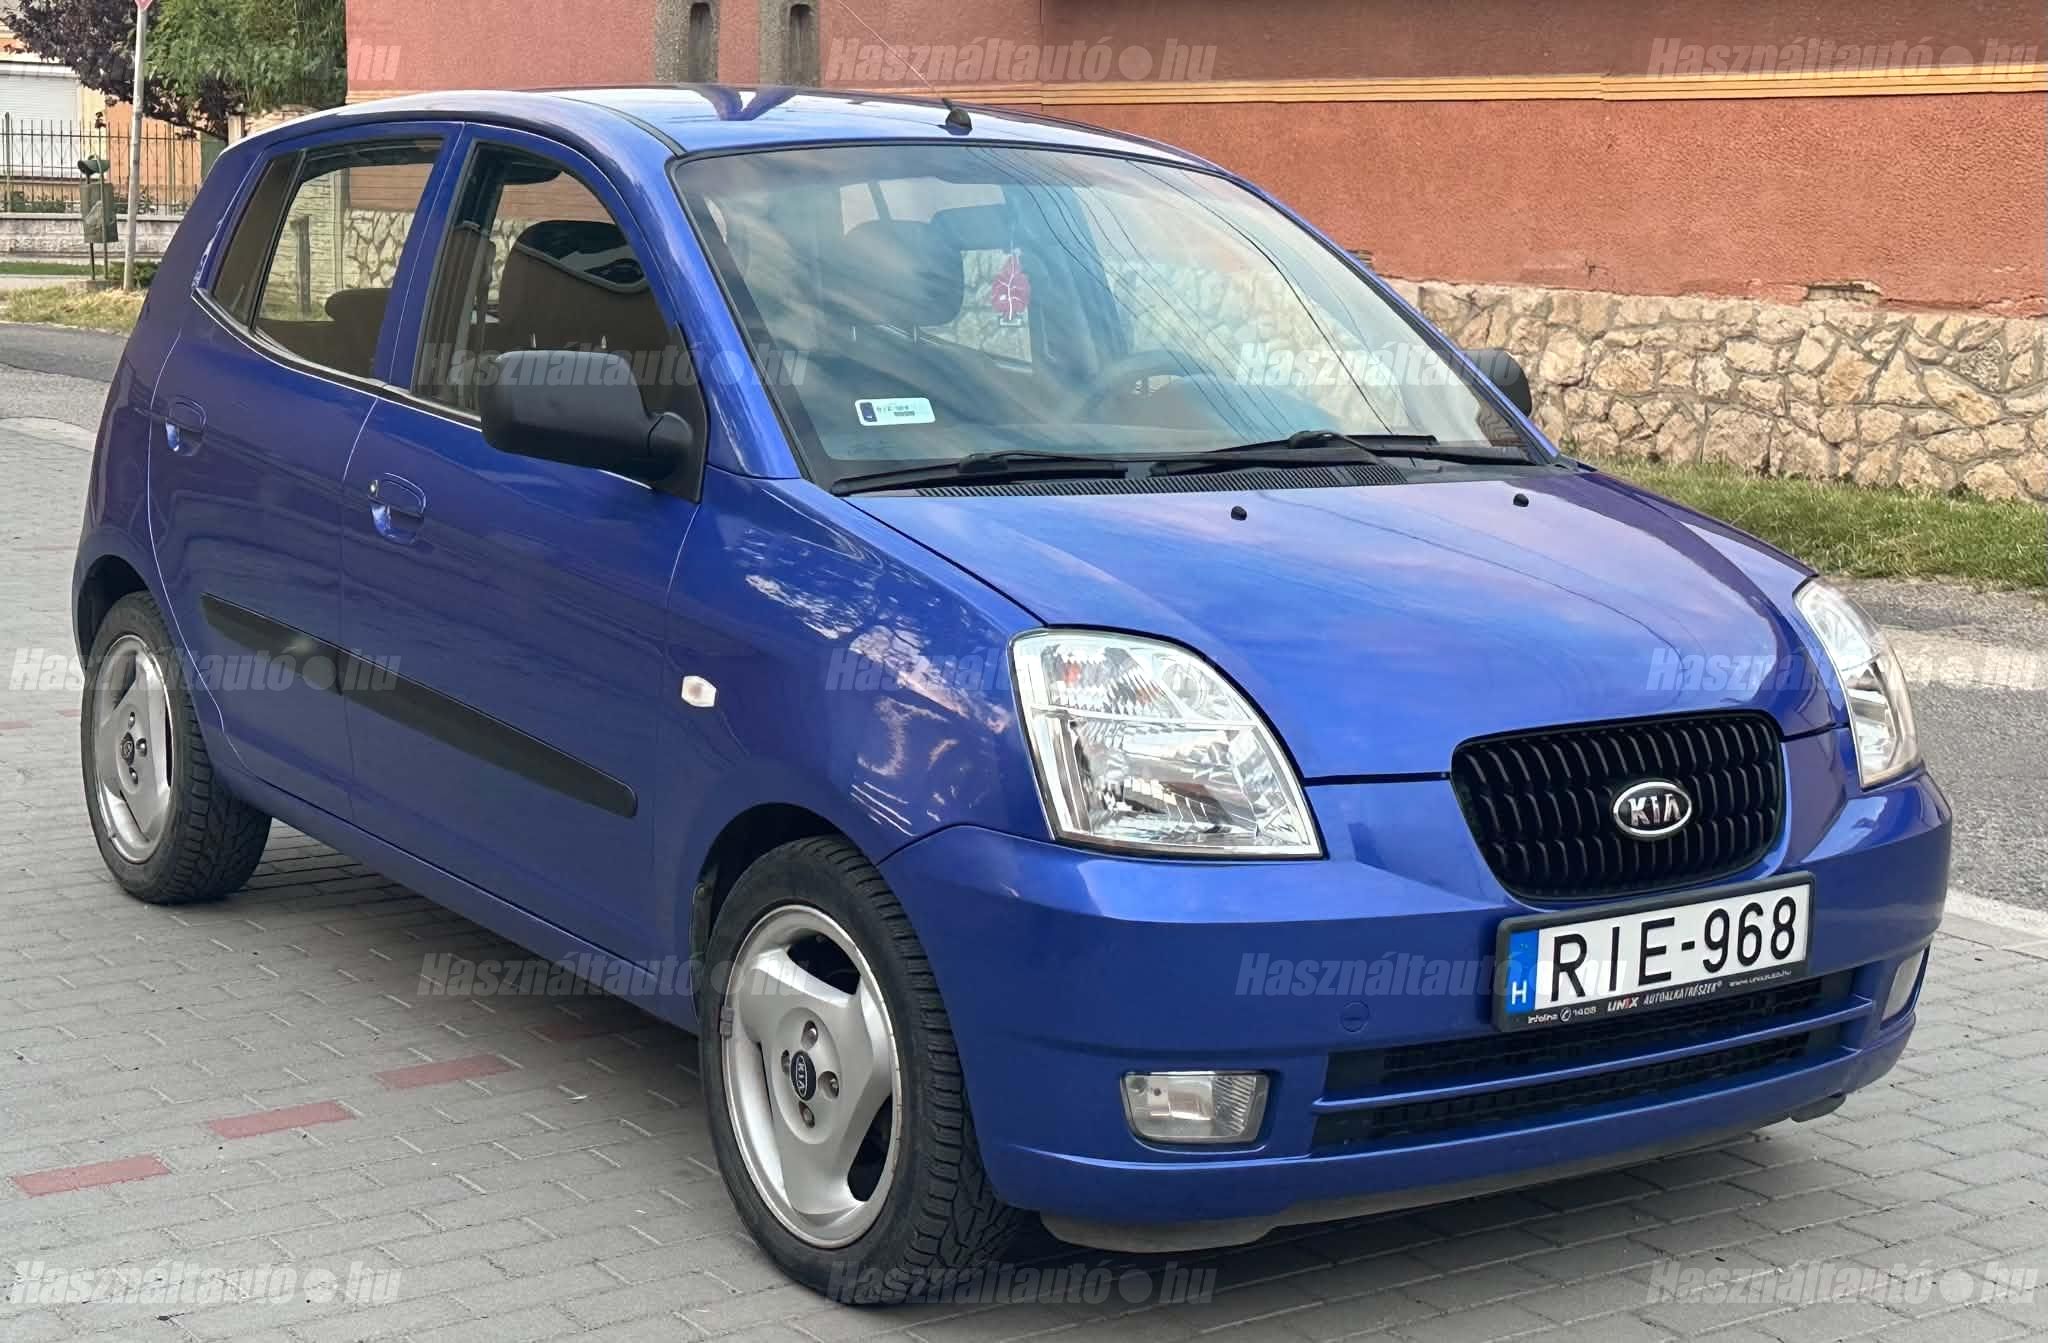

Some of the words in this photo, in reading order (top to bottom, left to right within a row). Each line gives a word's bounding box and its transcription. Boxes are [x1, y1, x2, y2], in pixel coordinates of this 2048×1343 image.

[1628, 793, 1681, 827] KIA
[1550, 896, 1797, 1002] RIE-968
[1511, 979, 1527, 1005] H
